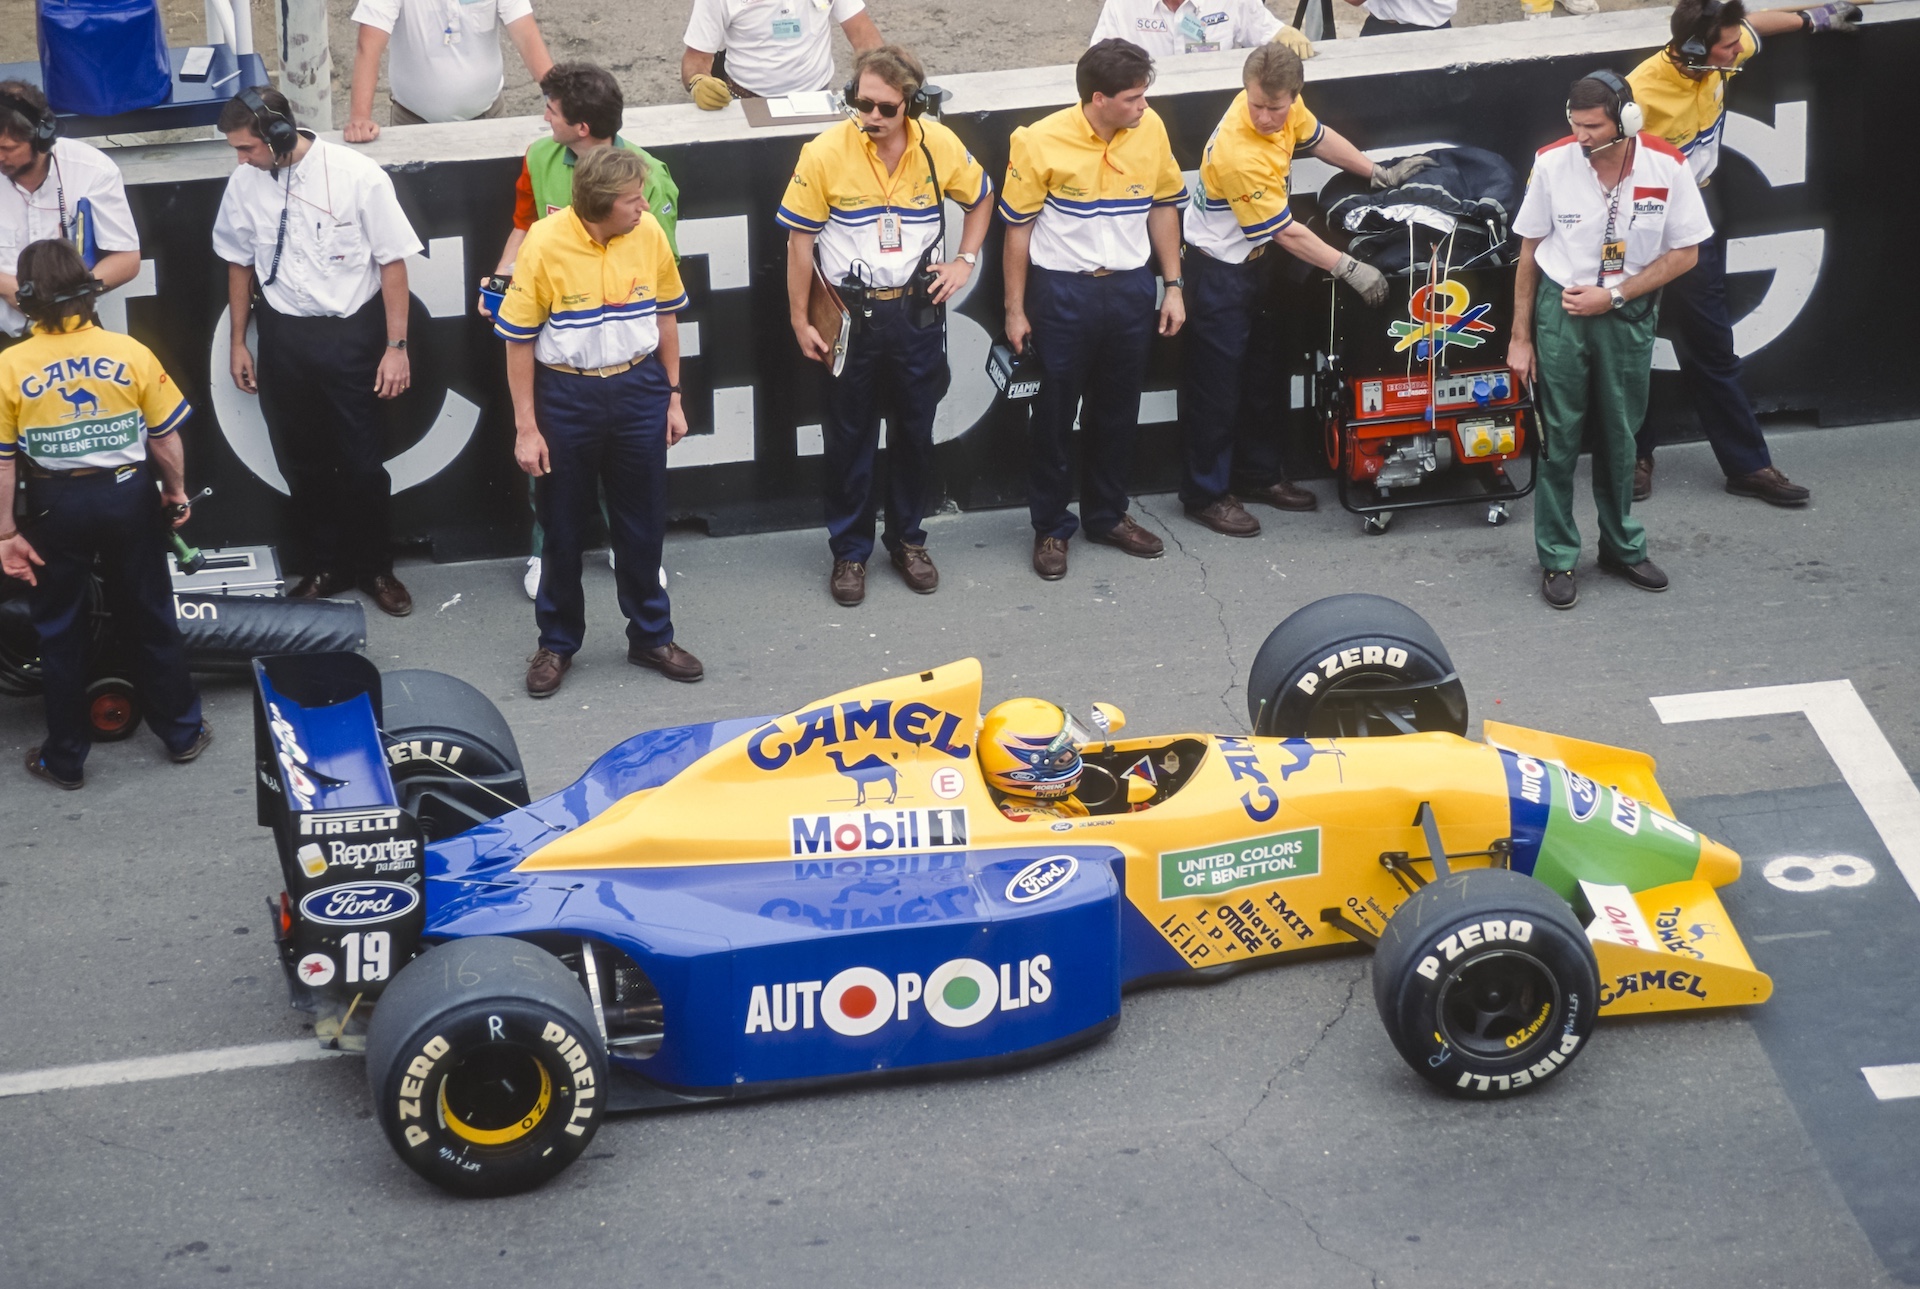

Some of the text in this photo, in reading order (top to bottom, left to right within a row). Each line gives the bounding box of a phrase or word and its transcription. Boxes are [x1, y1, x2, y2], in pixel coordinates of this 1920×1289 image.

[1137, 20, 1166, 30] SCCA
[1634, 201, 1664, 212] Marlboro
[21, 356, 131, 399] CAMEL
[1009, 381, 1041, 395] FIAMM
[1387, 381, 1429, 392] HONDA
[31, 416, 135, 442] UNITED COLORS
[41, 443, 60, 454] OF
[1296, 645, 1409, 696] P ZERO
[746, 699, 972, 771] CAMEL
[385, 740, 463, 768] ELLI
[940, 774, 957, 793] E
[1013, 773, 1034, 781] Ford
[1031, 782, 1067, 791] MORENO
[1213, 735, 1279, 823] CAM
[300, 809, 400, 836] PIRELLI
[792, 811, 919, 855] Mobil
[1052, 822, 1073, 831] Ford
[1087, 819, 1116, 827] MORENO
[328, 837, 418, 870] Reporter
[1178, 840, 1303, 874] UNITED COLORS
[1019, 862, 1066, 894] Ford
[1183, 873, 1206, 888] OF
[1763, 854, 1876, 892] 8
[325, 888, 395, 917] Ford
[1265, 891, 1314, 941] IMIT
[1346, 897, 1367, 920] O.Z.
[1238, 899, 1283, 950] Diavia
[1604, 905, 1641, 948] ANYO
[340, 931, 391, 983] 19
[1416, 919, 1533, 981] P ZERO
[744, 954, 1052, 1037] AUTOPOLIS
[1599, 969, 1707, 1007] CAMEL
[488, 1015, 506, 1041] R
[1505, 1027, 1533, 1050] O.Z.
[541, 1021, 597, 1137] PIRELLI
[1456, 1034, 1582, 1092] PIRELLI
[399, 1035, 451, 1148] P ZERO
